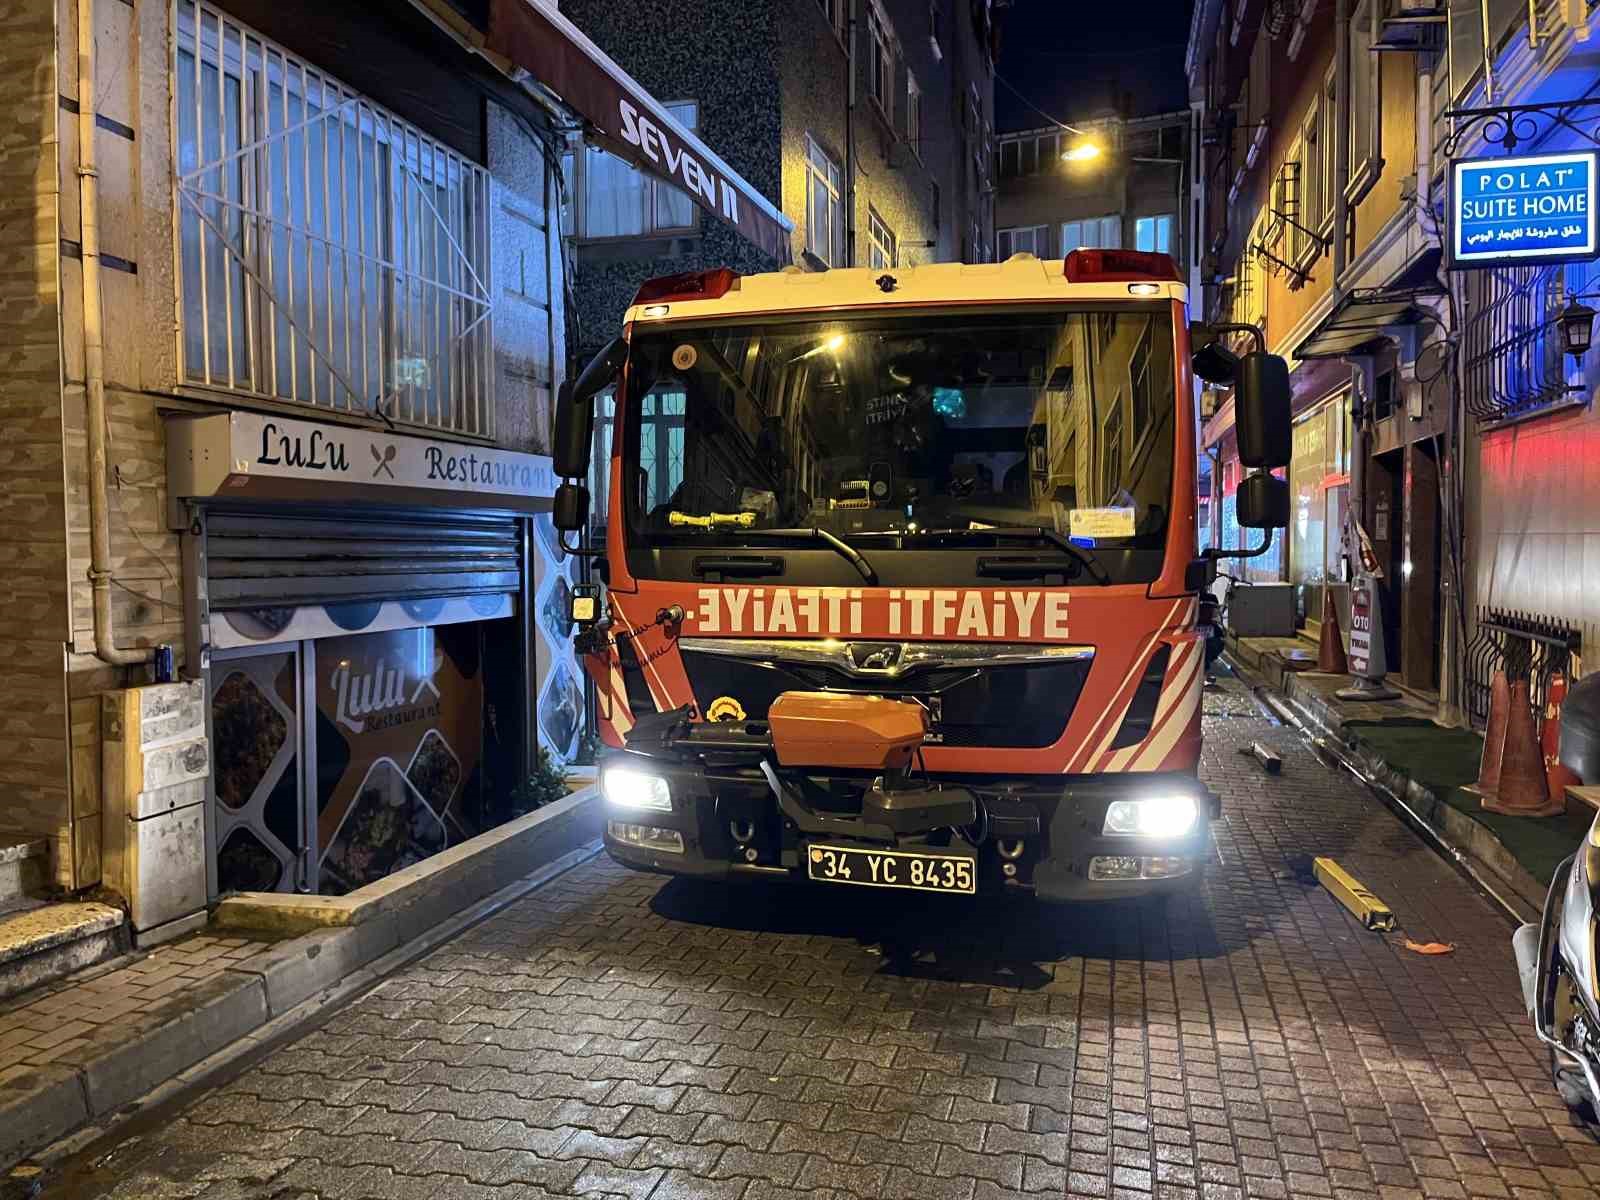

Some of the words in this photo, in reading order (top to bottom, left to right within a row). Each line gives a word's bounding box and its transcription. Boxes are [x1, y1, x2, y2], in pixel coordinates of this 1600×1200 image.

[620, 99, 716, 208] SEVEN
[1480, 169, 1567, 191] POLAT
[1463, 198, 1517, 219] SUITE
[1523, 193, 1586, 215] HOME
[257, 423, 350, 471] LuLu
[1353, 615, 1369, 631] OTO
[331, 659, 405, 734] Lulu
[366, 702, 441, 732] Restaurant
[823, 851, 851, 879] 34
[867, 855, 897, 883] YC
[910, 859, 971, 889] 8435
